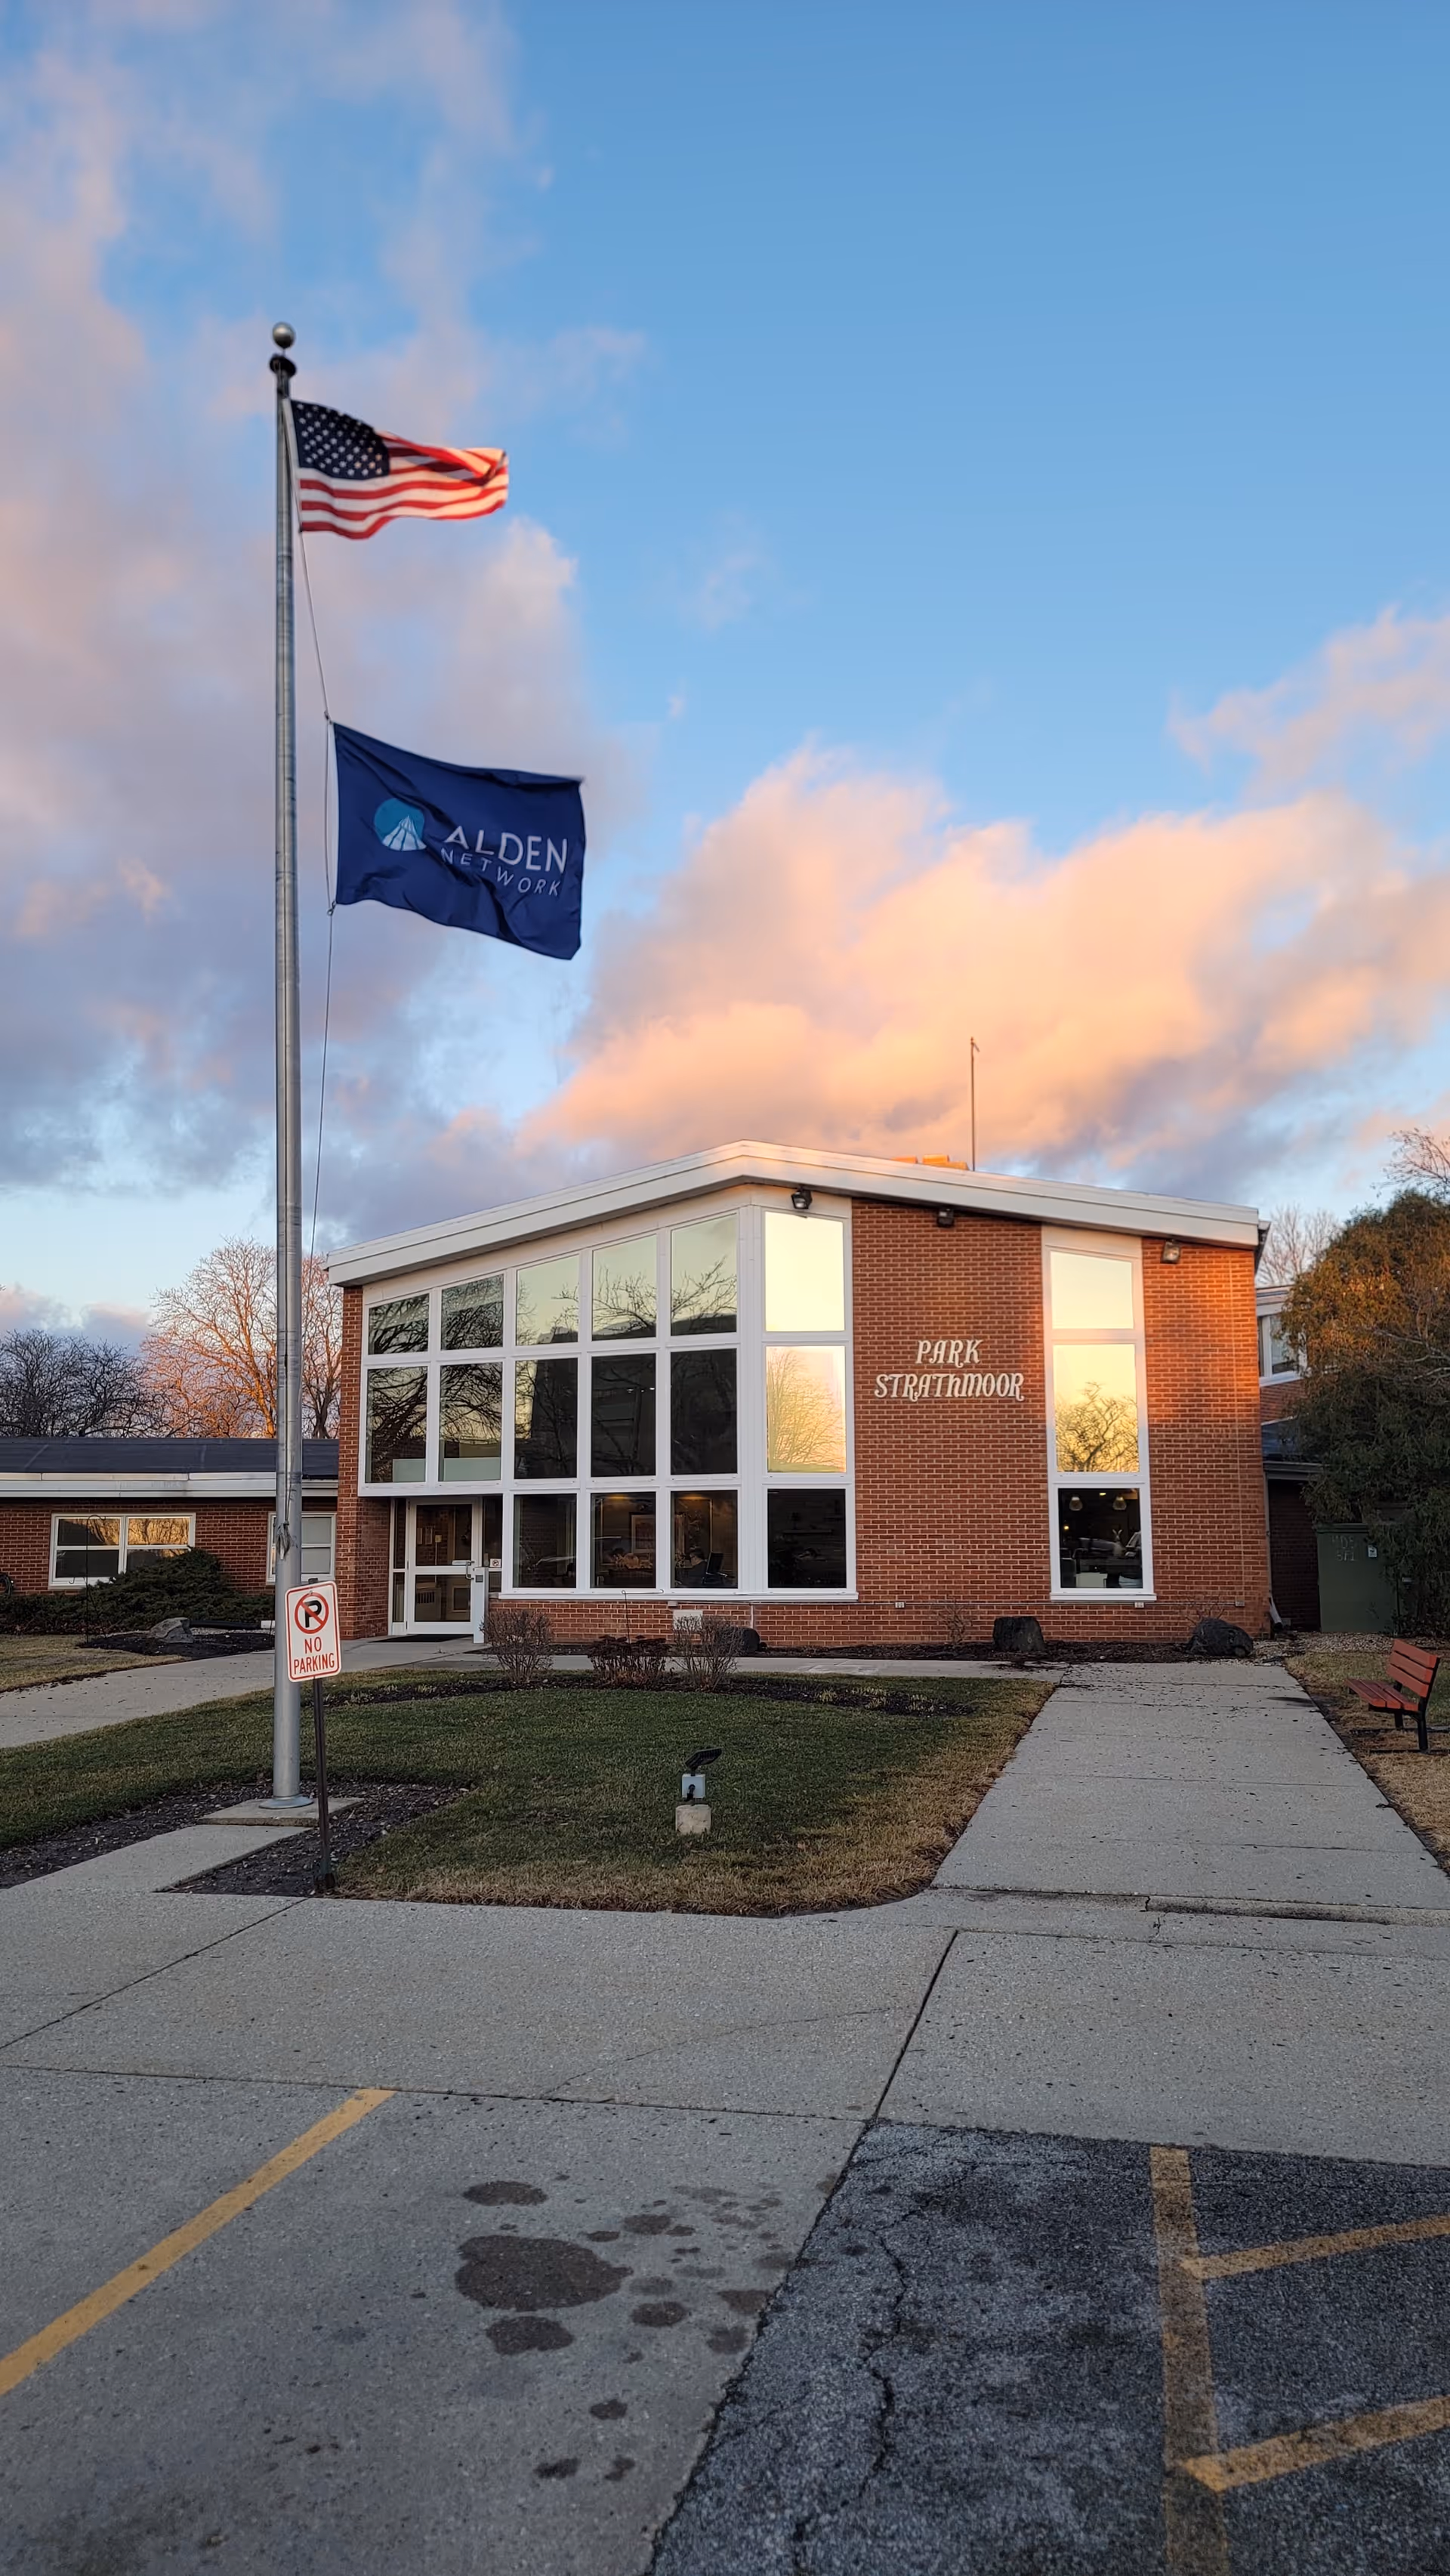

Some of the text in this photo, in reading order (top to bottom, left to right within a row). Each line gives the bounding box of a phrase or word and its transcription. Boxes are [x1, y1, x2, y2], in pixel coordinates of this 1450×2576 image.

[444, 826, 568, 873] ALDEN
[441, 847, 561, 897] NETWORK
[915, 1339, 983, 1368] PARK
[874, 1373, 1024, 1402] STRATHMOOR
[304, 1636, 322, 1654] NO
[294, 1653, 335, 1675] PARKING
